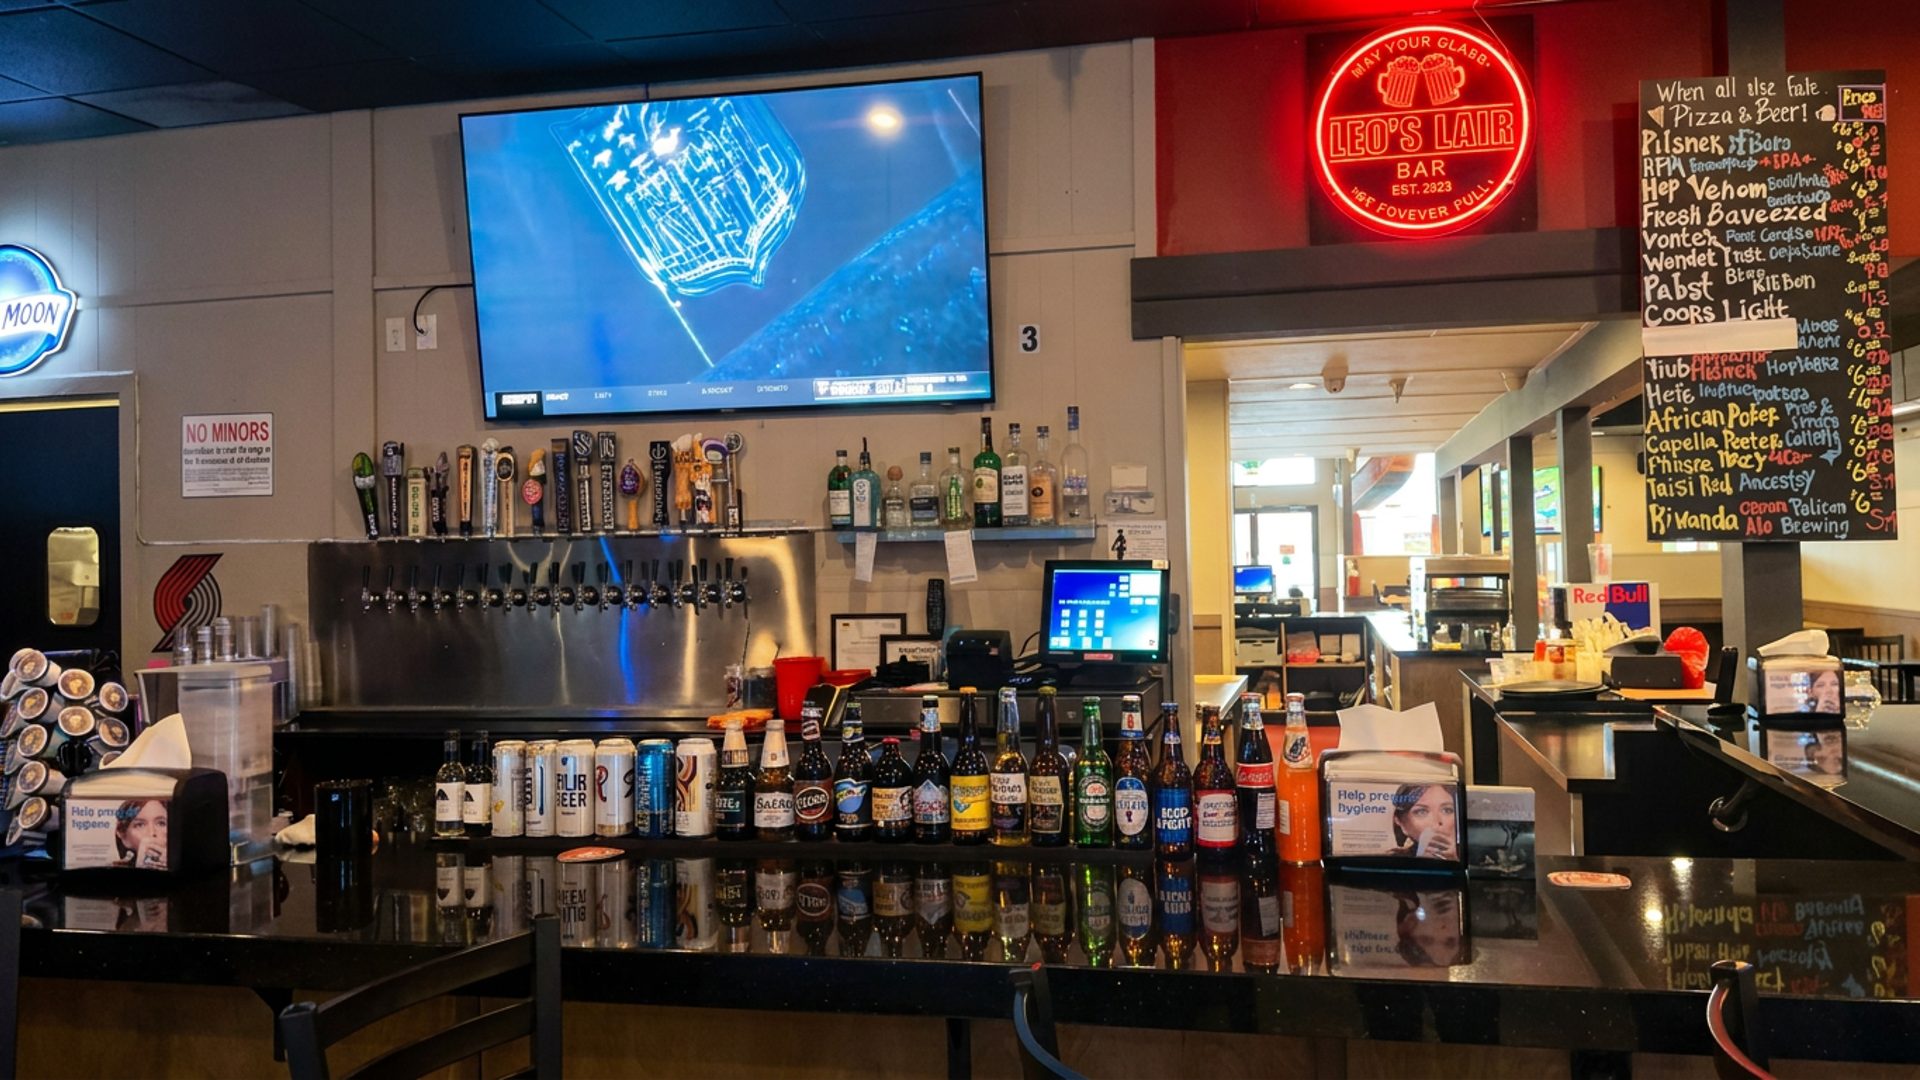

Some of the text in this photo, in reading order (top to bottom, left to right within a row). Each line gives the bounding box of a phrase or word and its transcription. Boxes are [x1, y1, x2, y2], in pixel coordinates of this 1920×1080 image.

[1351, 48, 1382, 78] MAY
[1385, 35, 1431, 53] YOUR
[1715, 77, 1736, 98] all
[1669, 97, 1807, 128] Pizza & Beer!
[1329, 109, 1515, 158] LEO'S LAIR
[1397, 159, 1446, 179] BAR
[1391, 182, 1420, 196] EST.
[2, 301, 60, 330] MOON
[1021, 325, 1038, 352] 3
[186, 421, 270, 443] NO MINORS
[1645, 406, 1725, 434] African
[1646, 432, 1719, 458] Capella
[1573, 584, 1648, 604] Red Bull
